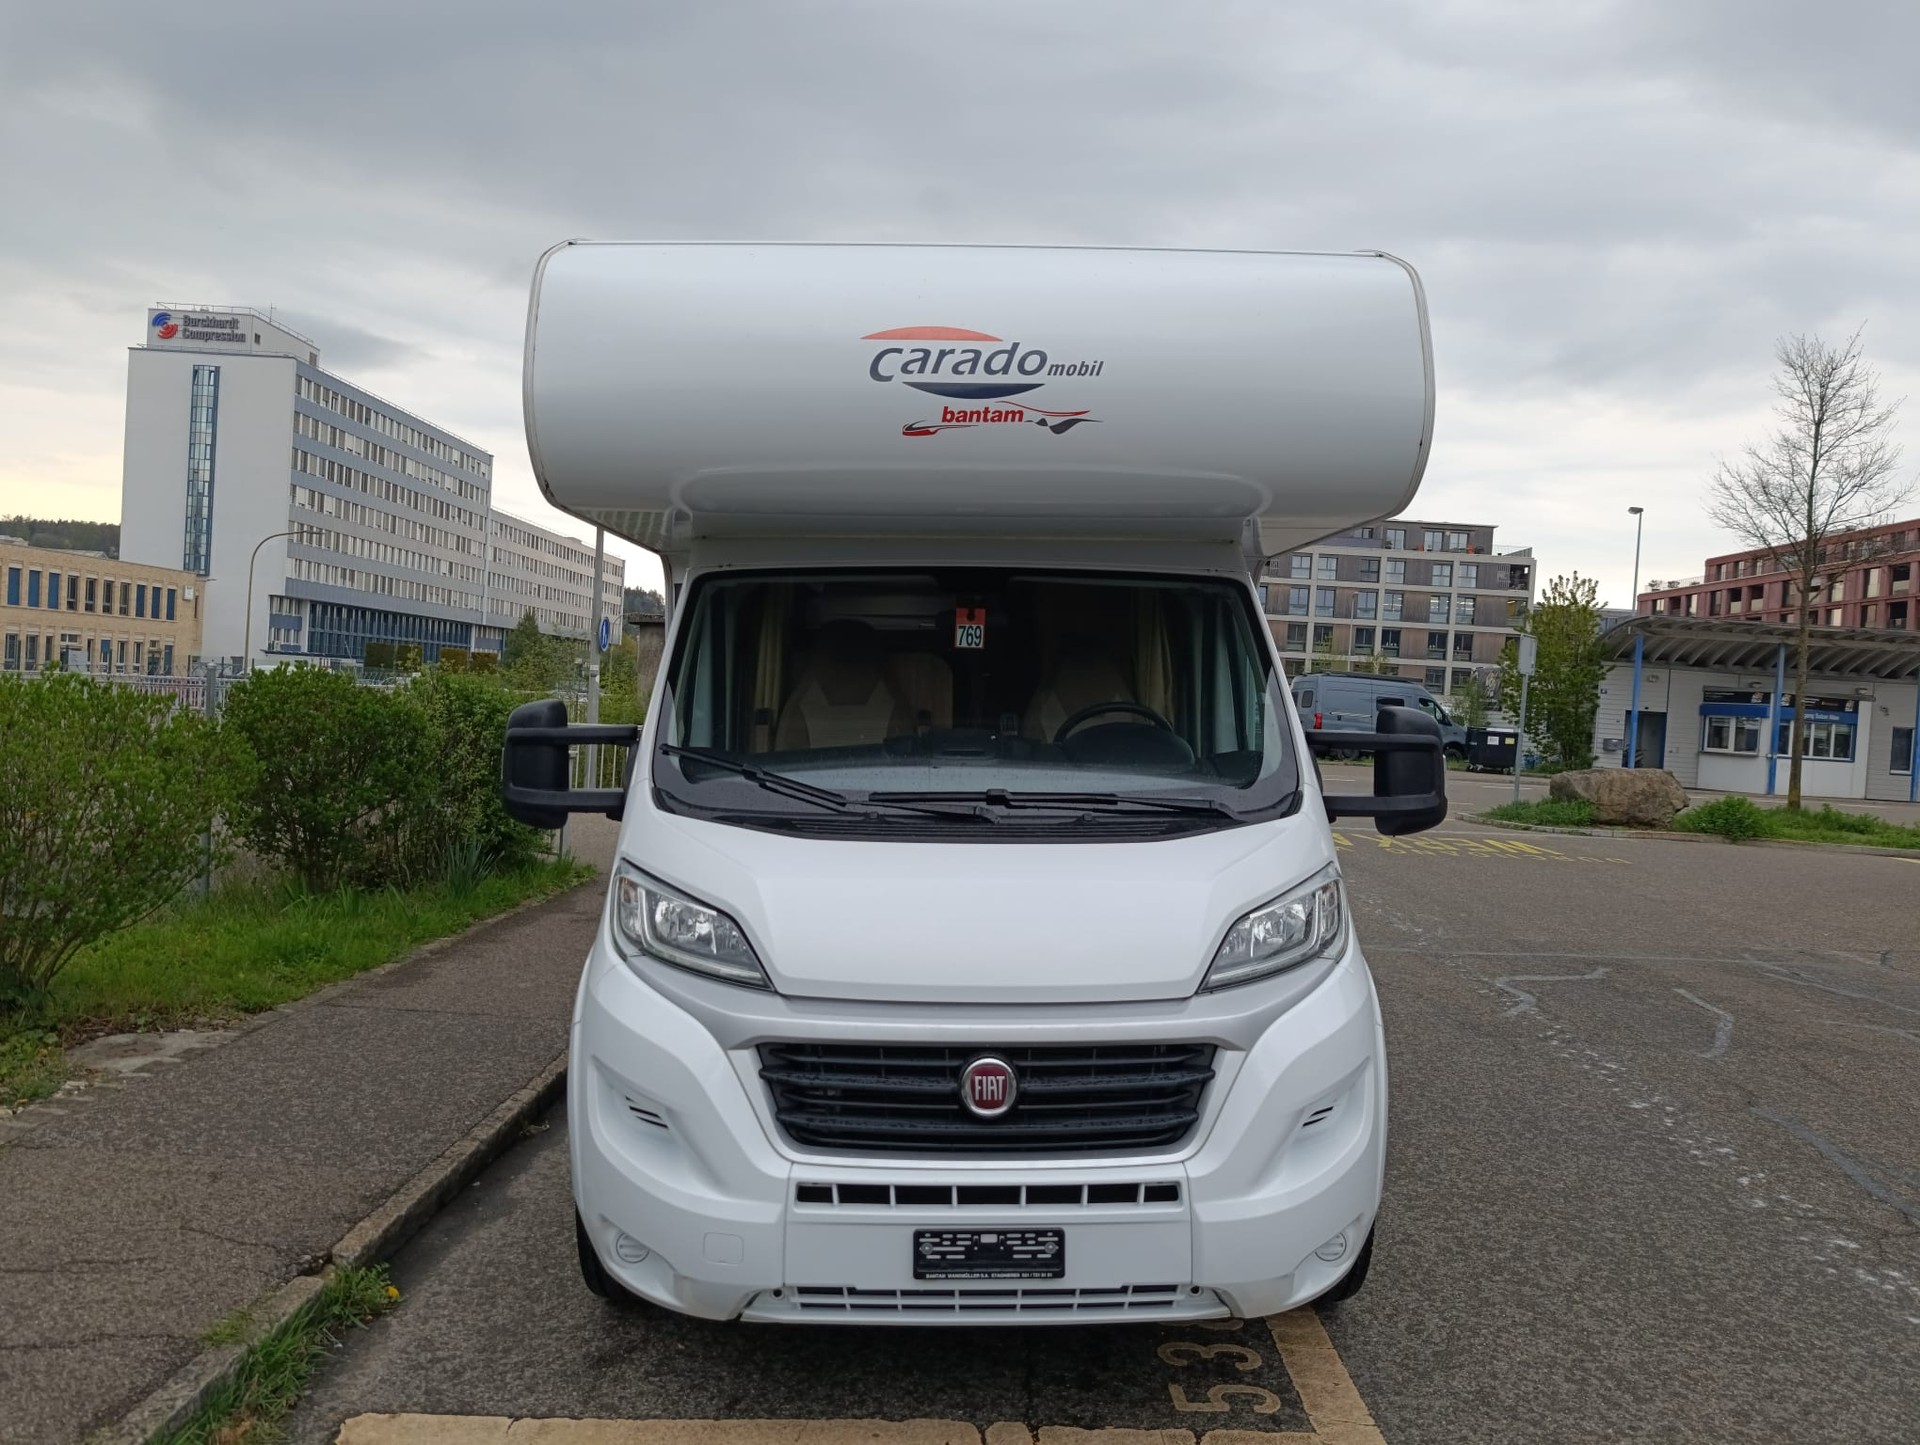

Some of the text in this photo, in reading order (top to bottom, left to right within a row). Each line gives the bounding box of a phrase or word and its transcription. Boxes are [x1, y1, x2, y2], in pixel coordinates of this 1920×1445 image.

[182, 314, 240, 330] Burckhardt
[181, 329, 246, 343] Compression
[1047, 361, 1104, 377] mobil
[942, 406, 1024, 423] bantam
[958, 625, 982, 647] 769
[974, 1076, 1006, 1101] FIAT
